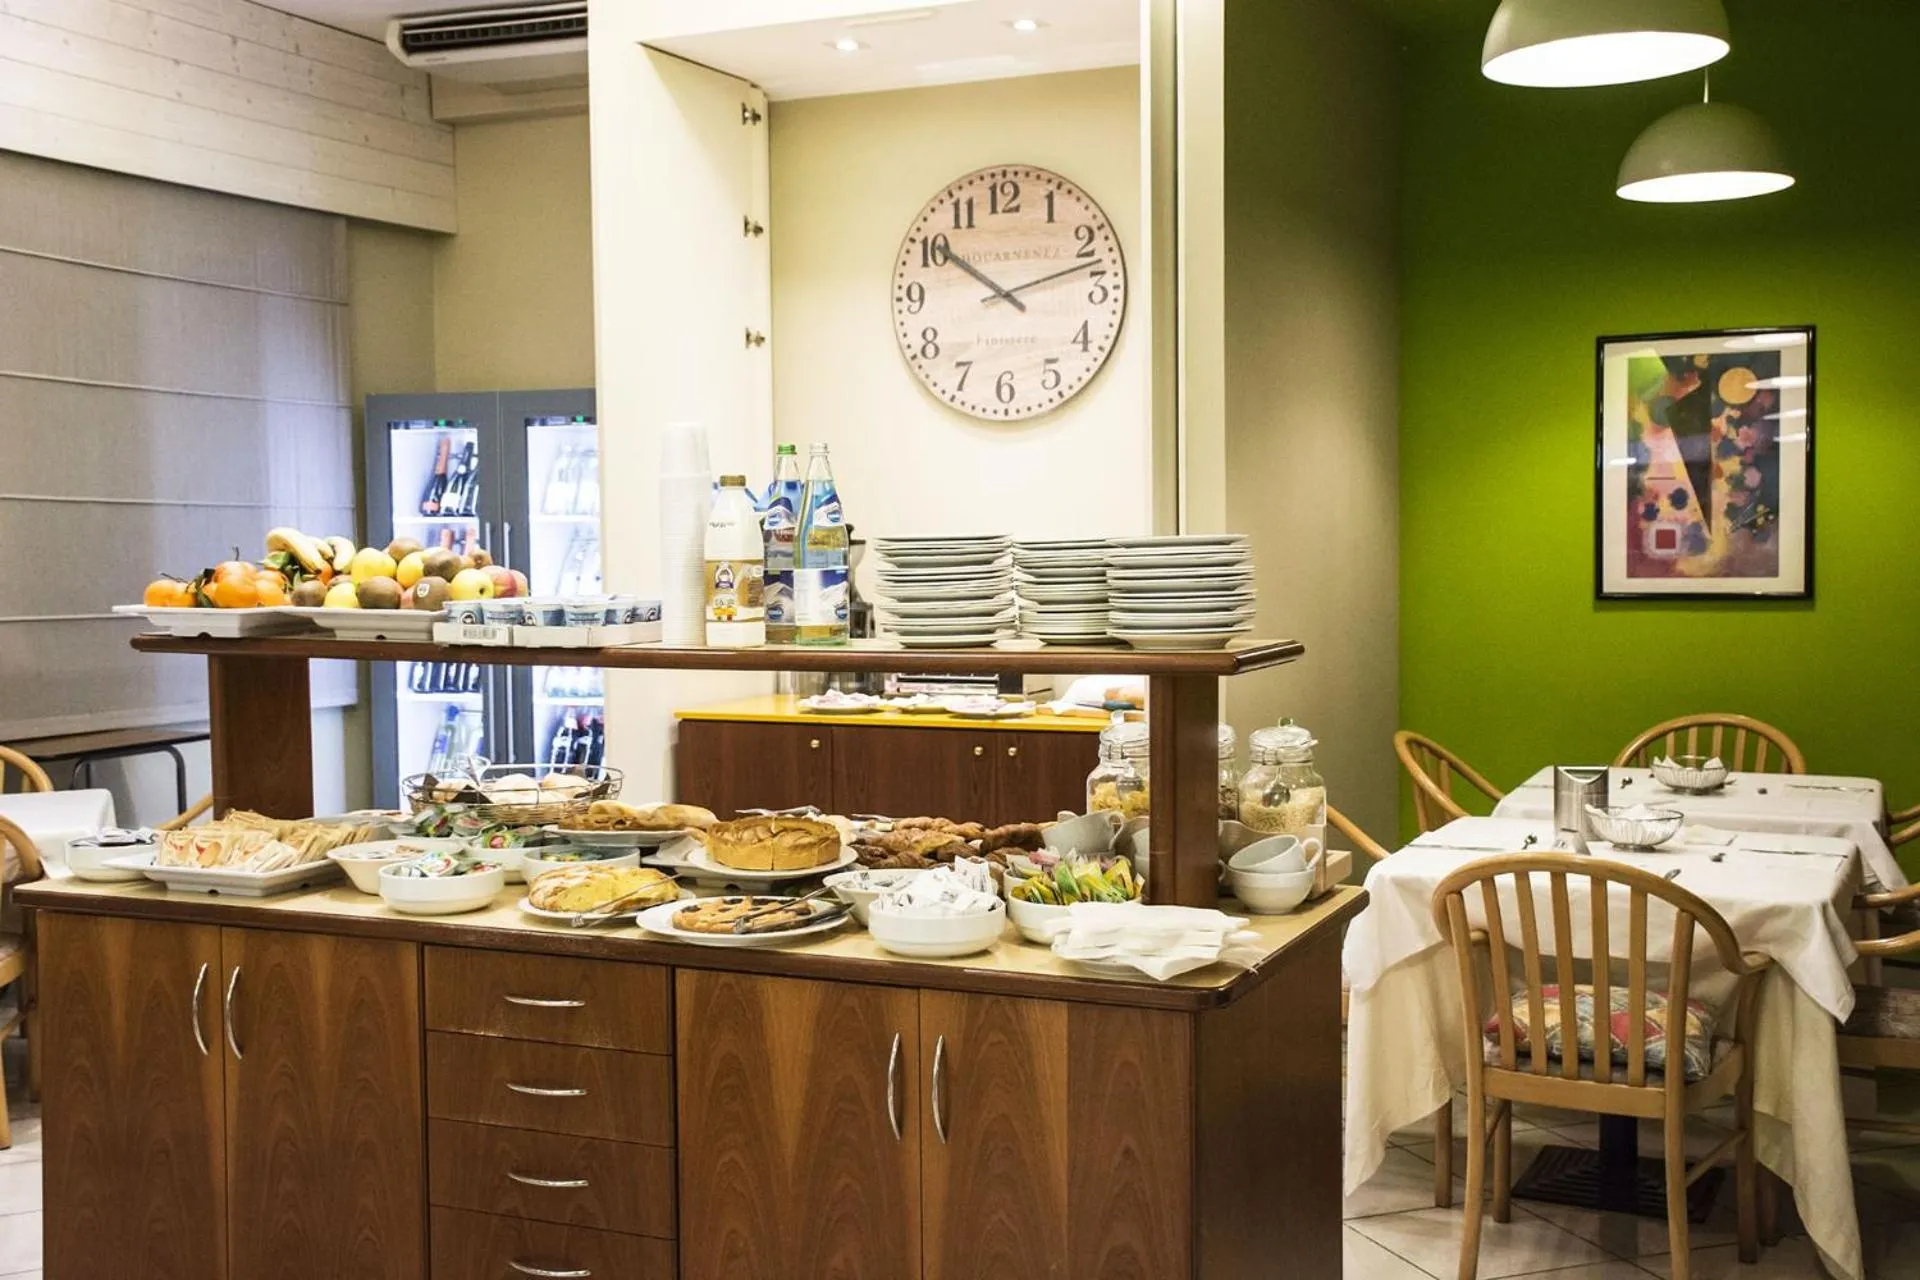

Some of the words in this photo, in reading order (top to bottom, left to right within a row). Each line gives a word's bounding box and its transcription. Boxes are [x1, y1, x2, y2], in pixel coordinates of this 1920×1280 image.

[952, 196, 976, 230] 11
[988, 180, 1021, 215] 12
[1044, 189, 1056, 224] 1
[920, 232, 950, 268] 10
[1074, 224, 1096, 258] 2
[906, 281, 926, 315] 9
[1088, 270, 1109, 305] 3
[920, 327, 941, 360] 8
[1071, 320, 1093, 353] 4
[954, 361, 973, 392] 7
[995, 370, 1016, 404] 6
[1041, 357, 1062, 390] 5
